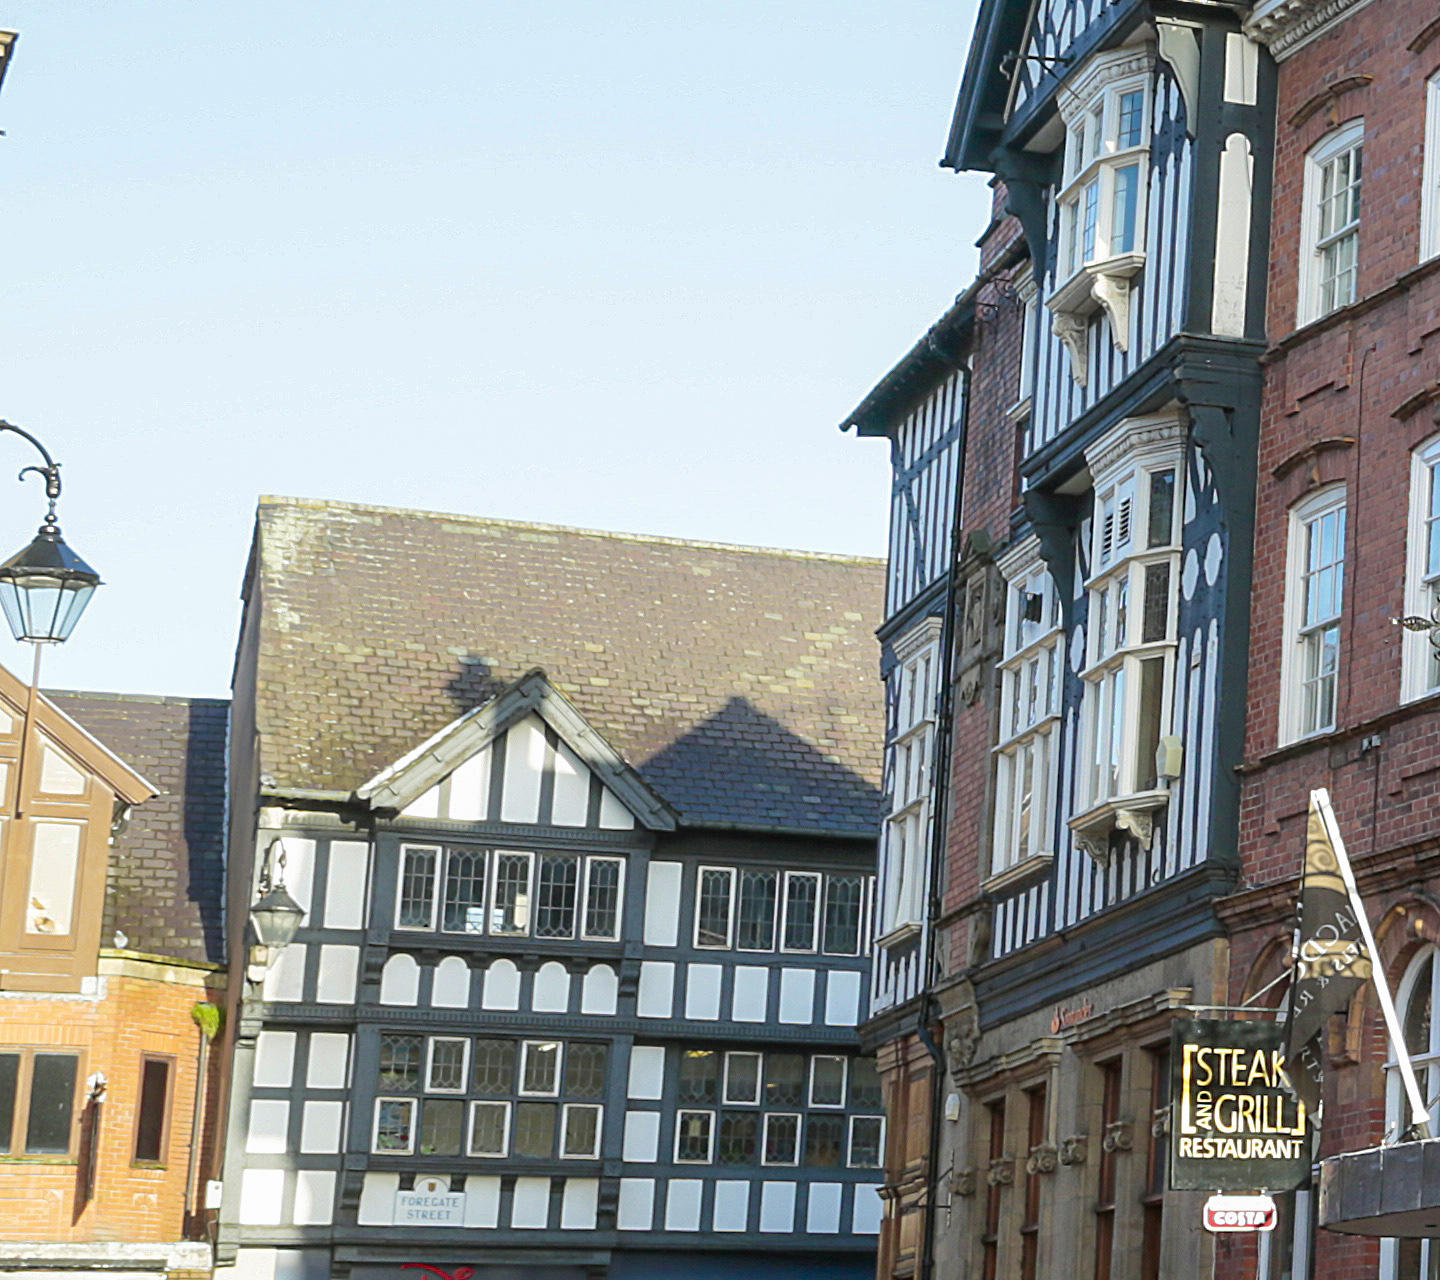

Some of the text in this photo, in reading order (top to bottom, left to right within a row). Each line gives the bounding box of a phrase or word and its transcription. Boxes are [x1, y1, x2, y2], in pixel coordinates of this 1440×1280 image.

[1196, 1047, 1291, 1087] STEAK
[1196, 1091, 1212, 1130] AND
[1214, 1094, 1291, 1133] GRILL
[1179, 1138, 1303, 1159] RESTAURANT
[402, 1196, 459, 1208] FOREGATE
[406, 1209, 452, 1220] STREET
[1213, 1211, 1267, 1227] COSTA
